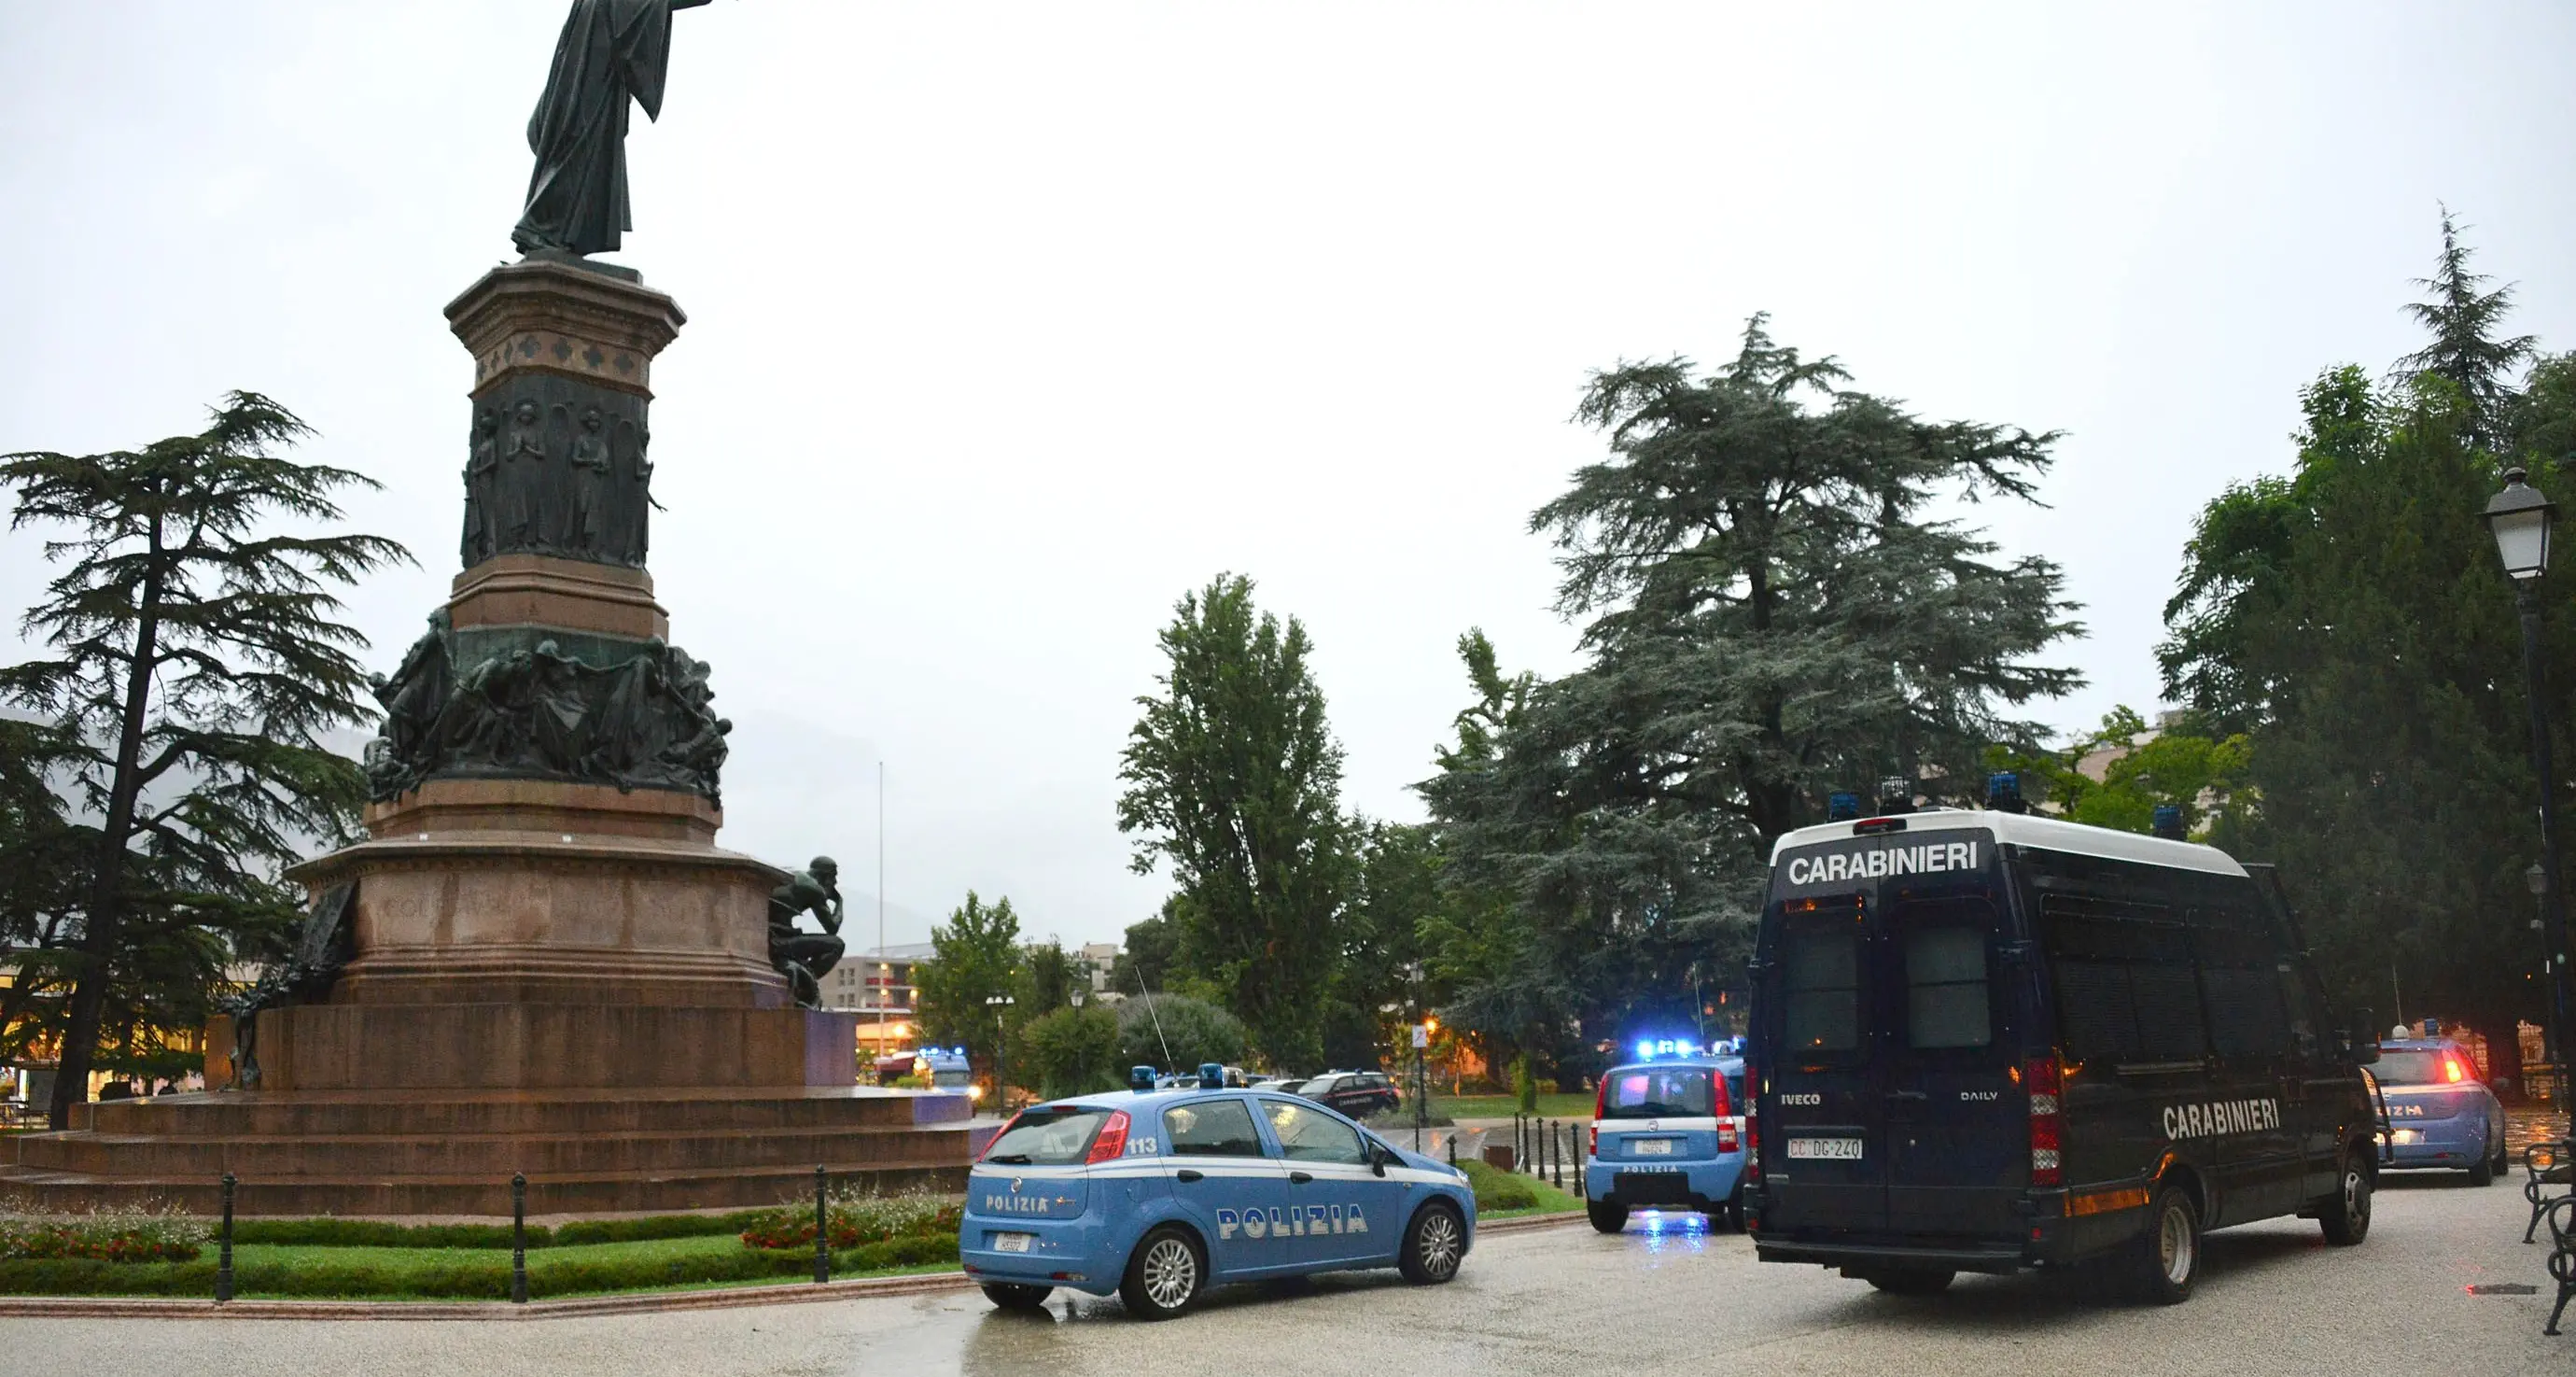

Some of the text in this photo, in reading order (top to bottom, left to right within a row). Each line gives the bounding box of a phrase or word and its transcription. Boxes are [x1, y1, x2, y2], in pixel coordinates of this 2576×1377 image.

[1788, 841, 1977, 885] CARABINIERI
[1781, 1093, 1821, 1105] IVECO
[1960, 1091, 1998, 1101] DAILY
[2163, 1098, 2279, 1140] CARABINIERI
[2375, 1104, 2424, 1117] LIZIA
[1127, 1136, 1157, 1155] 113
[1623, 1164, 1678, 1173] POLIZIA
[987, 1194, 1049, 1213] POLIZIA
[1216, 1203, 1368, 1240] POLIZIA
